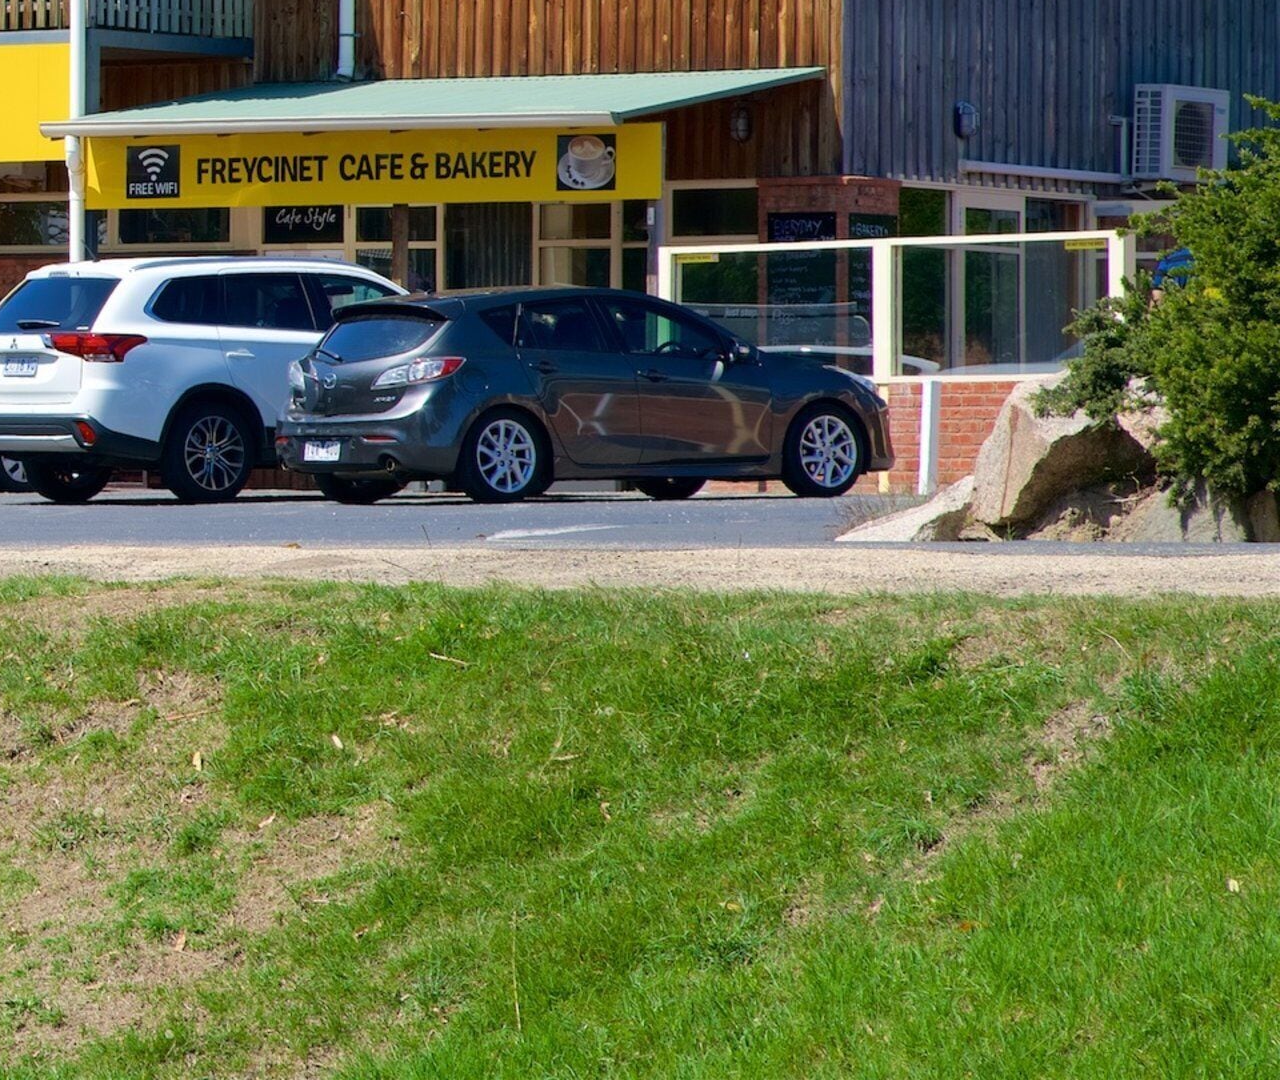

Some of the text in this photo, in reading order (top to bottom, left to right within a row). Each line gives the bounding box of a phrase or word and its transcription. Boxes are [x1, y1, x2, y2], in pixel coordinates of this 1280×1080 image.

[197, 150, 536, 184] FREYCINET CAFE & BAKERY
[129, 182, 178, 195] FREE WIFI
[276, 208, 337, 231] Cafe Style
